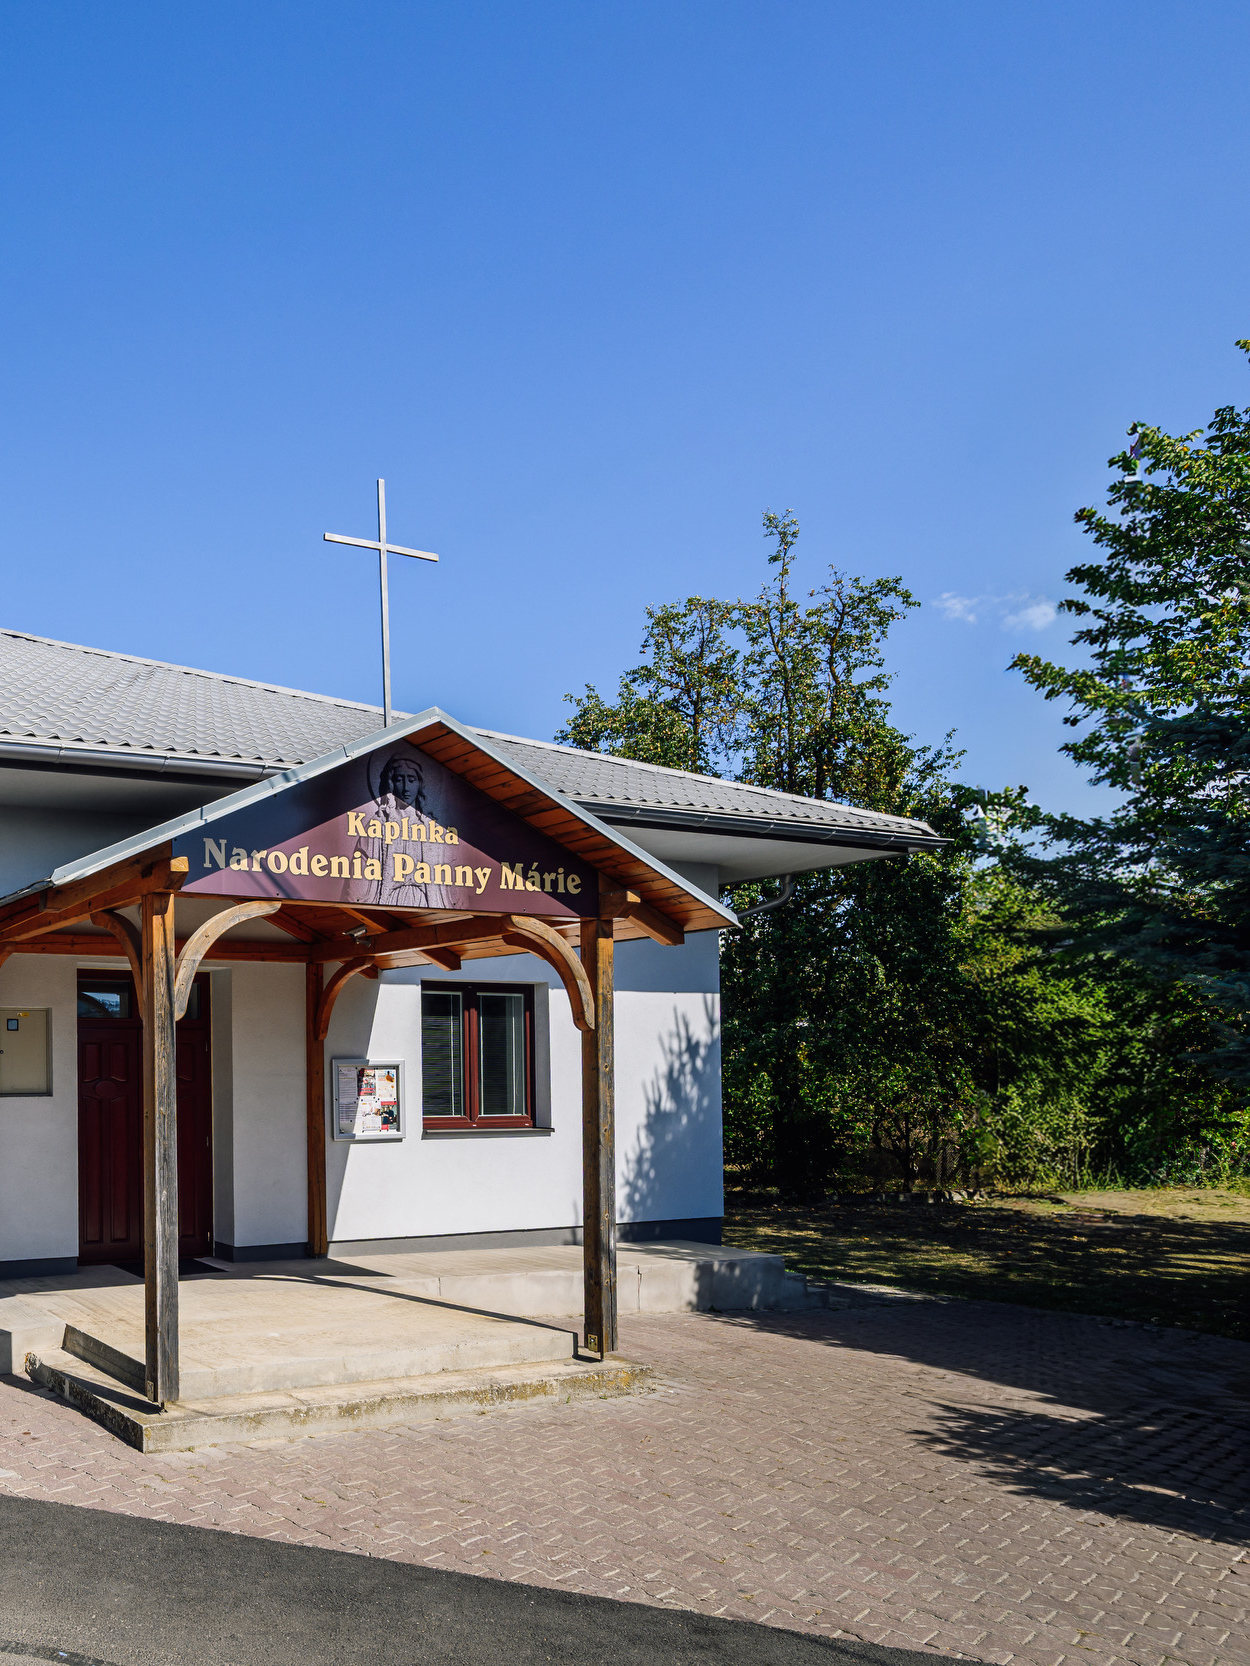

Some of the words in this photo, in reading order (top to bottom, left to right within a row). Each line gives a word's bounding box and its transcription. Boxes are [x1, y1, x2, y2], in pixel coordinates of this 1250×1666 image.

[347, 812, 460, 845] Kaplnka
[203, 838, 382, 881] Narodenia
[393, 854, 492, 895] Panny
[500, 862, 582, 894] Márie
